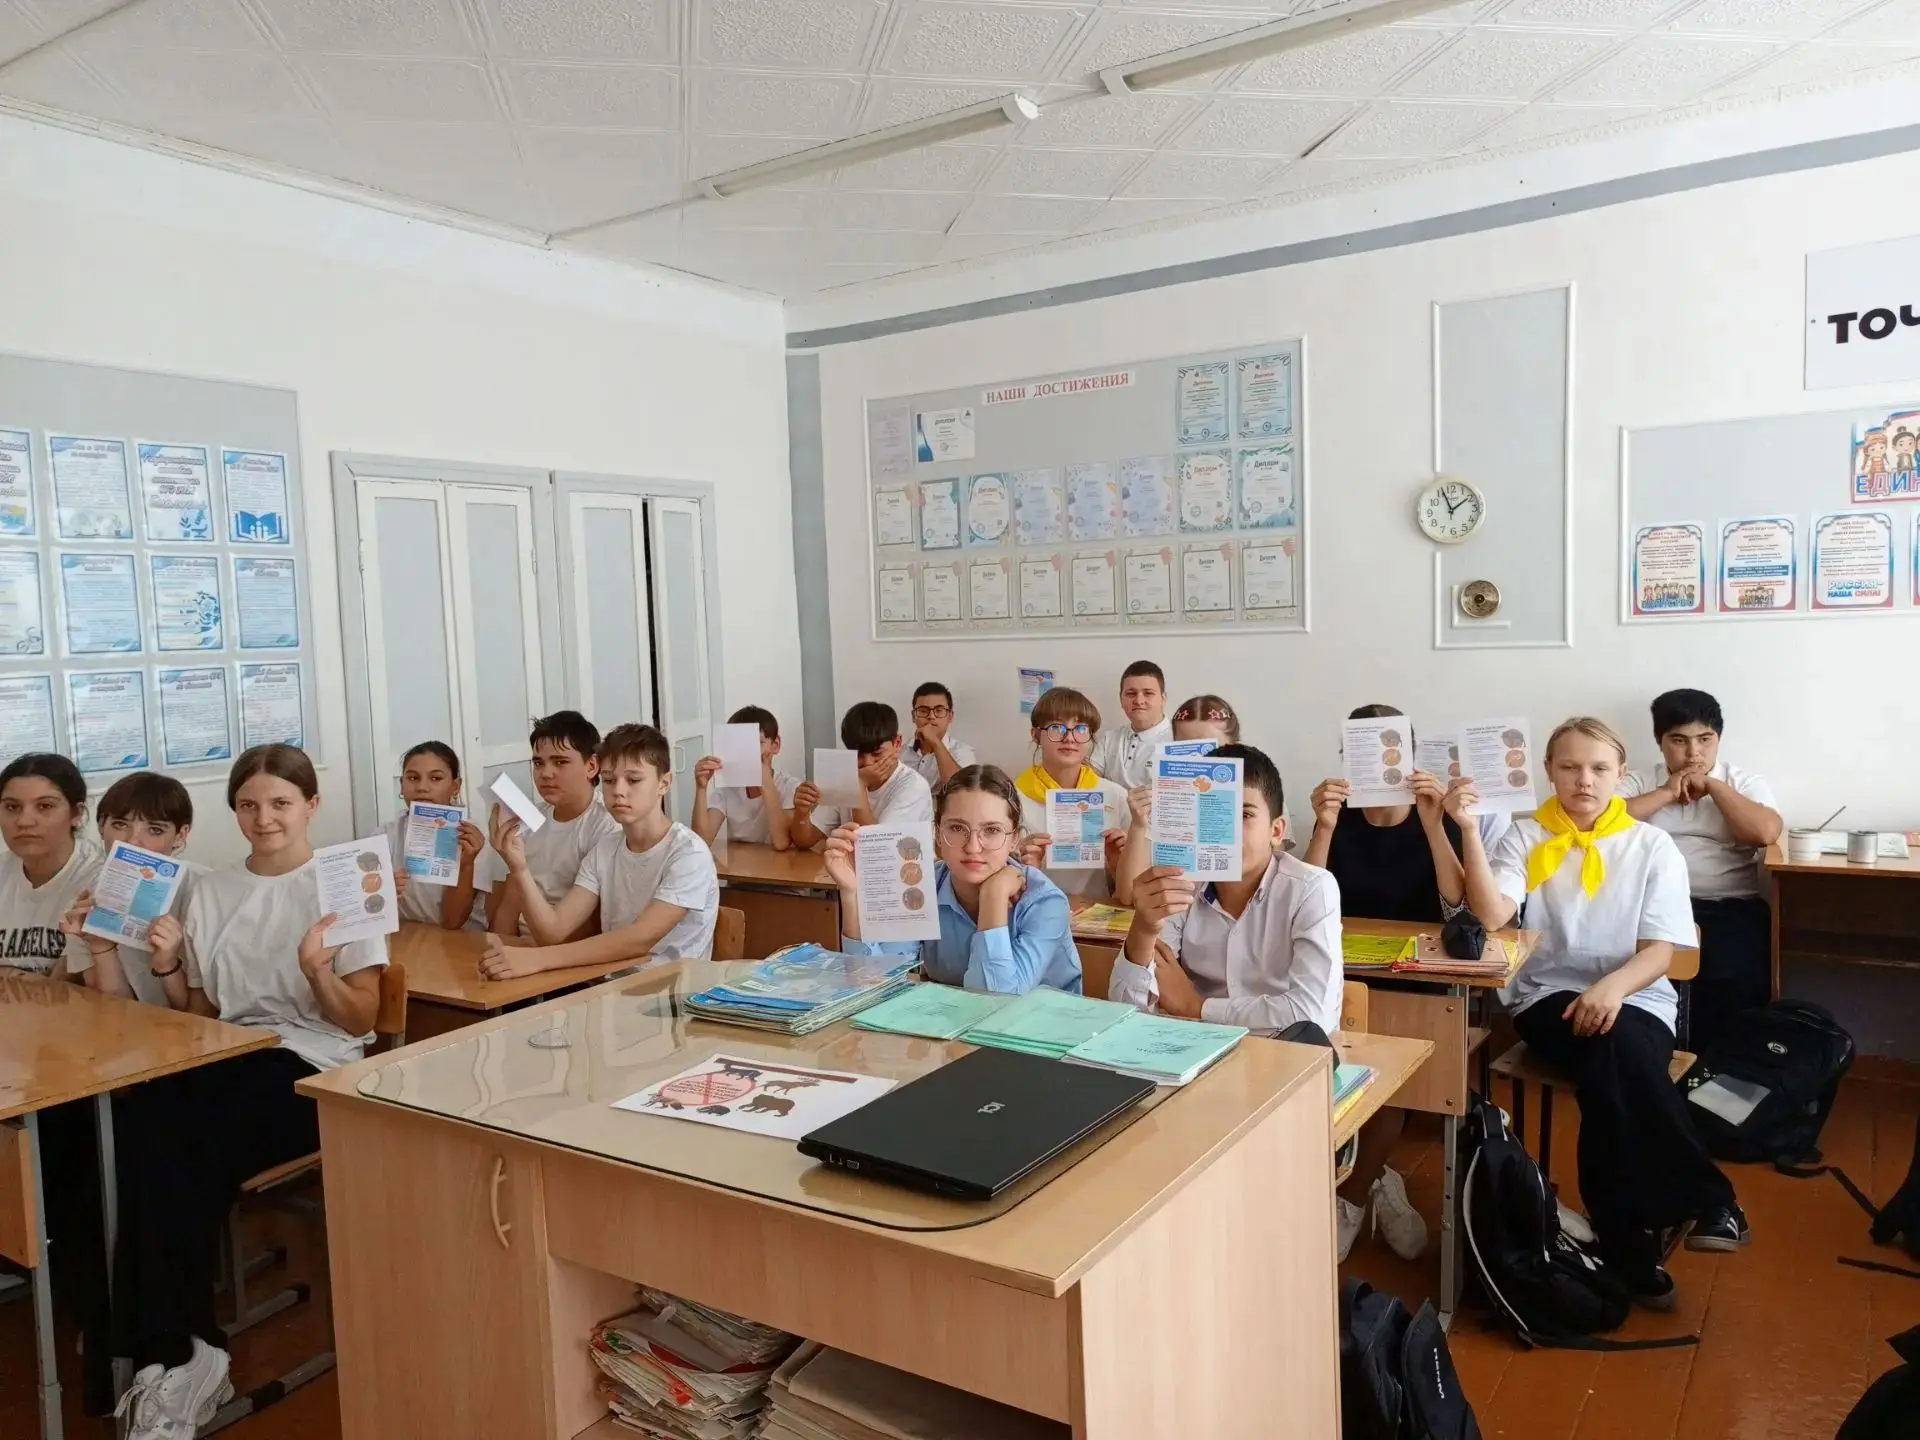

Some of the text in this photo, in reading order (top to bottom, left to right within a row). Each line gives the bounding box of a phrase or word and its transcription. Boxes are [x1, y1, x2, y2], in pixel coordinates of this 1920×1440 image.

[986, 372, 1129, 404] НАШИ ДОСТИЖЕНИЯ
[1446, 485, 1457, 494] 12
[1430, 498, 1440, 507] 10
[1467, 494, 1474, 503] 2
[1426, 508, 1434, 518] 9
[1471, 504, 1478, 513] 3
[1431, 518, 1438, 527] 8
[1468, 515, 1475, 523] 4
[1439, 525, 1446, 534] 7
[1450, 527, 1457, 536] 6
[1461, 523, 1468, 532] 5
[1828, 590, 1853, 598] НАША
